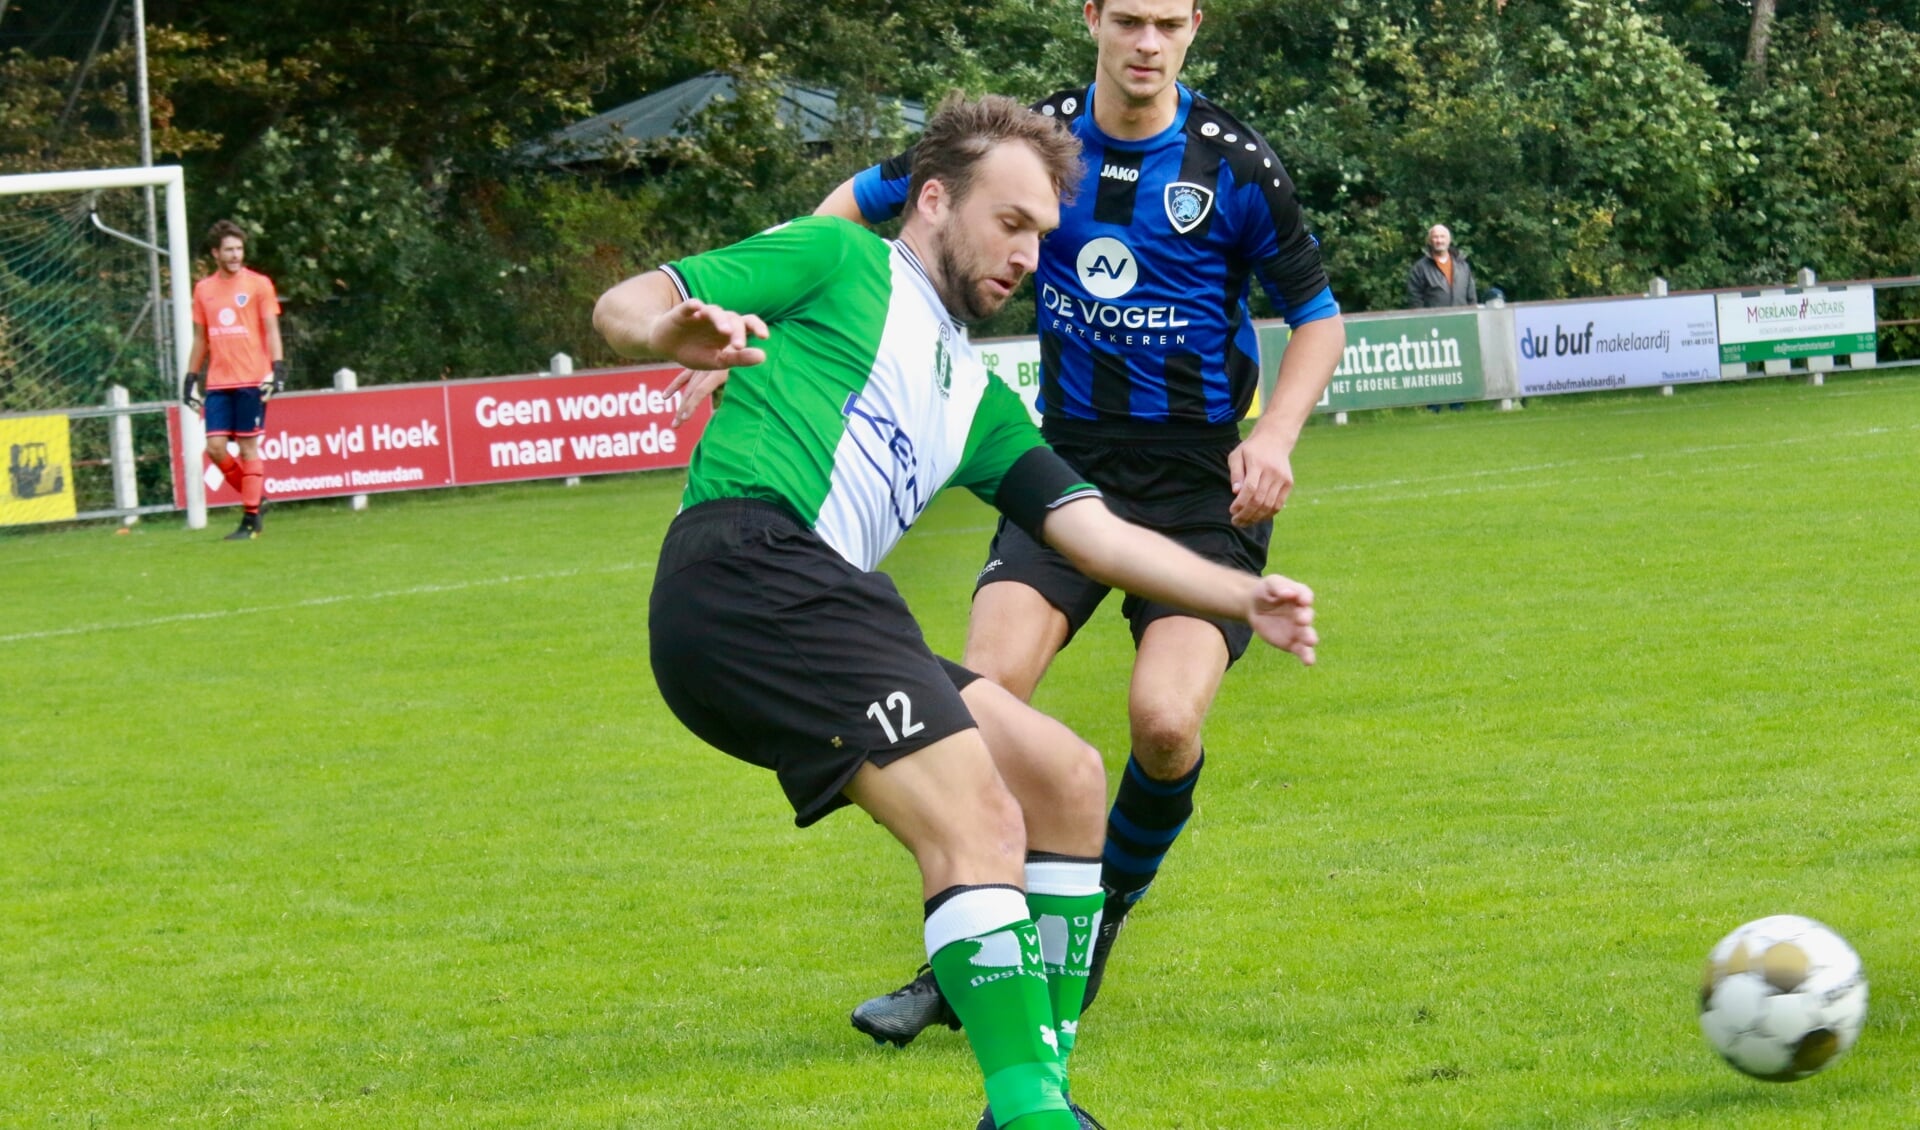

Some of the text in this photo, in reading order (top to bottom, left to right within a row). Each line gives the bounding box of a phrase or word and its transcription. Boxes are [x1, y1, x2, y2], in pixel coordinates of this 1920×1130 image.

[1100, 164, 1139, 182] JAKO
[1043, 283, 1189, 329] DE VOGEL
[1052, 319, 1185, 345] ERZEKEREN
[1520, 321, 1670, 359] du buf makelaardij
[1333, 328, 1462, 376] ntratuin
[1332, 371, 1463, 394] HET GROENE WARENHUIS
[1525, 374, 1626, 394] www.dubufmakelaardij.nl
[475, 383, 683, 428] Geen woorden
[372, 419, 439, 451] Hoek
[490, 422, 677, 467] maar waarde
[264, 477, 343, 493] Oostvoorne
[352, 468, 423, 486] Rotterdam
[866, 691, 925, 744] 12
